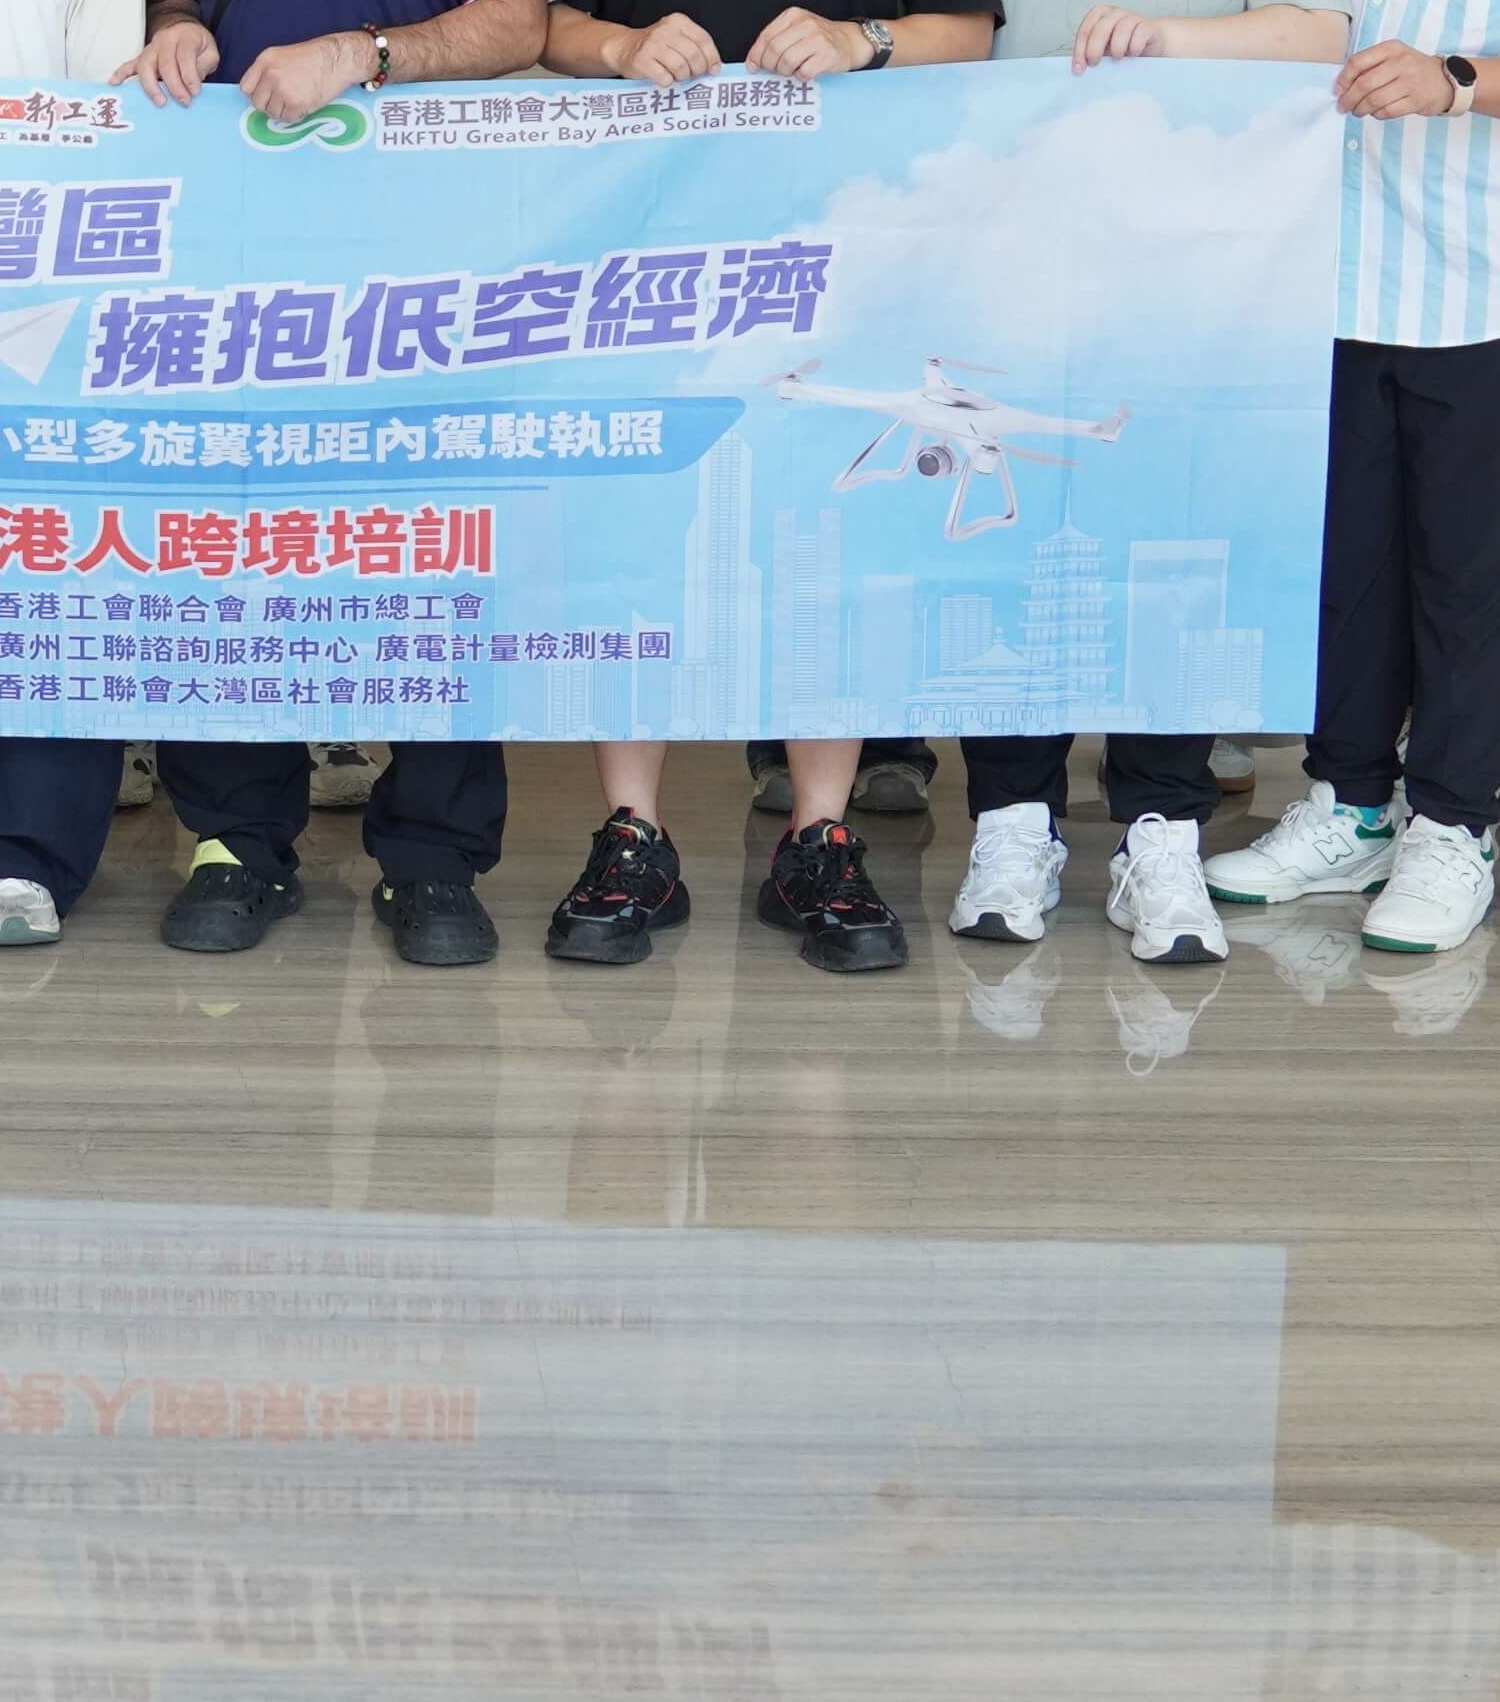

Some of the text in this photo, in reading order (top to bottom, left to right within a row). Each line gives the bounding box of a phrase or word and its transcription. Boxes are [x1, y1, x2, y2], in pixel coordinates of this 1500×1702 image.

[381, 79, 816, 127] 香港工聯會大灣區社會服務社
[382, 111, 816, 146] HKFTU Greater Bay Area Social Service
[90, 240, 834, 389] 擁抱低空經濟
[263, 591, 484, 622] 廣州市總工會
[376, 631, 672, 662] 廣電計量檢測集團
